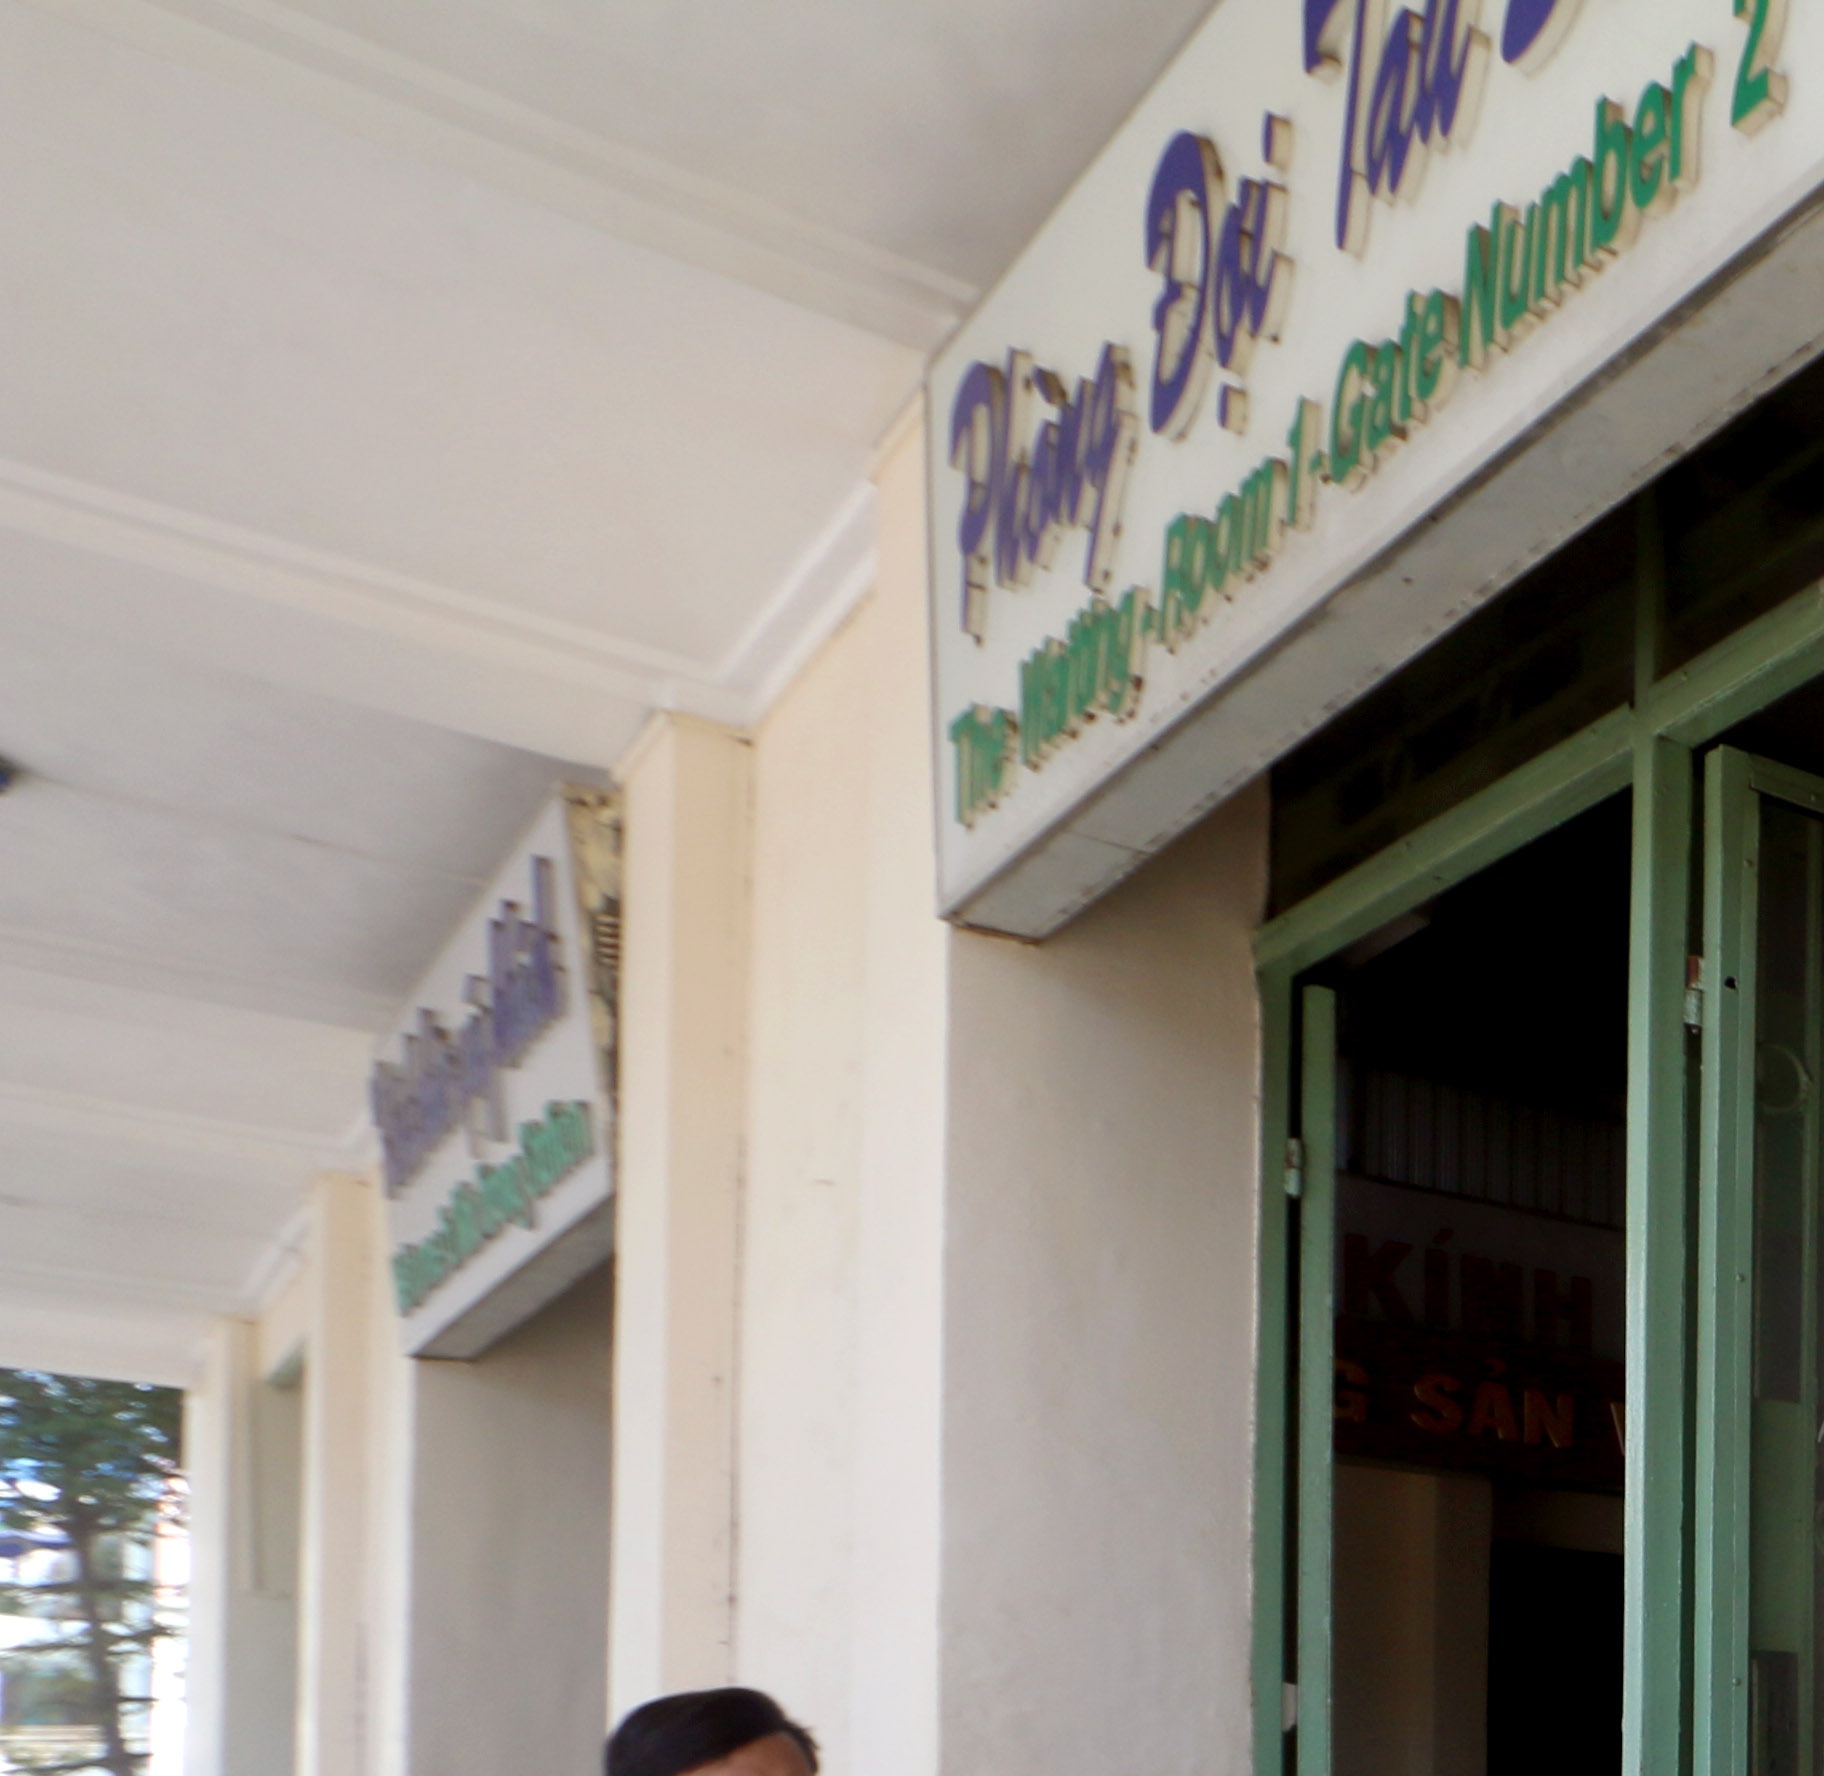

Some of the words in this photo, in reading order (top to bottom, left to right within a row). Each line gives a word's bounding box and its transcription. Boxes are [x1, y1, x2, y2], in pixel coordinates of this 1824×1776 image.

[1329, 288, 1459, 492] Gate
[1458, 40, 1714, 372] Number
[1344, 1228, 1592, 1352] KÍNH
